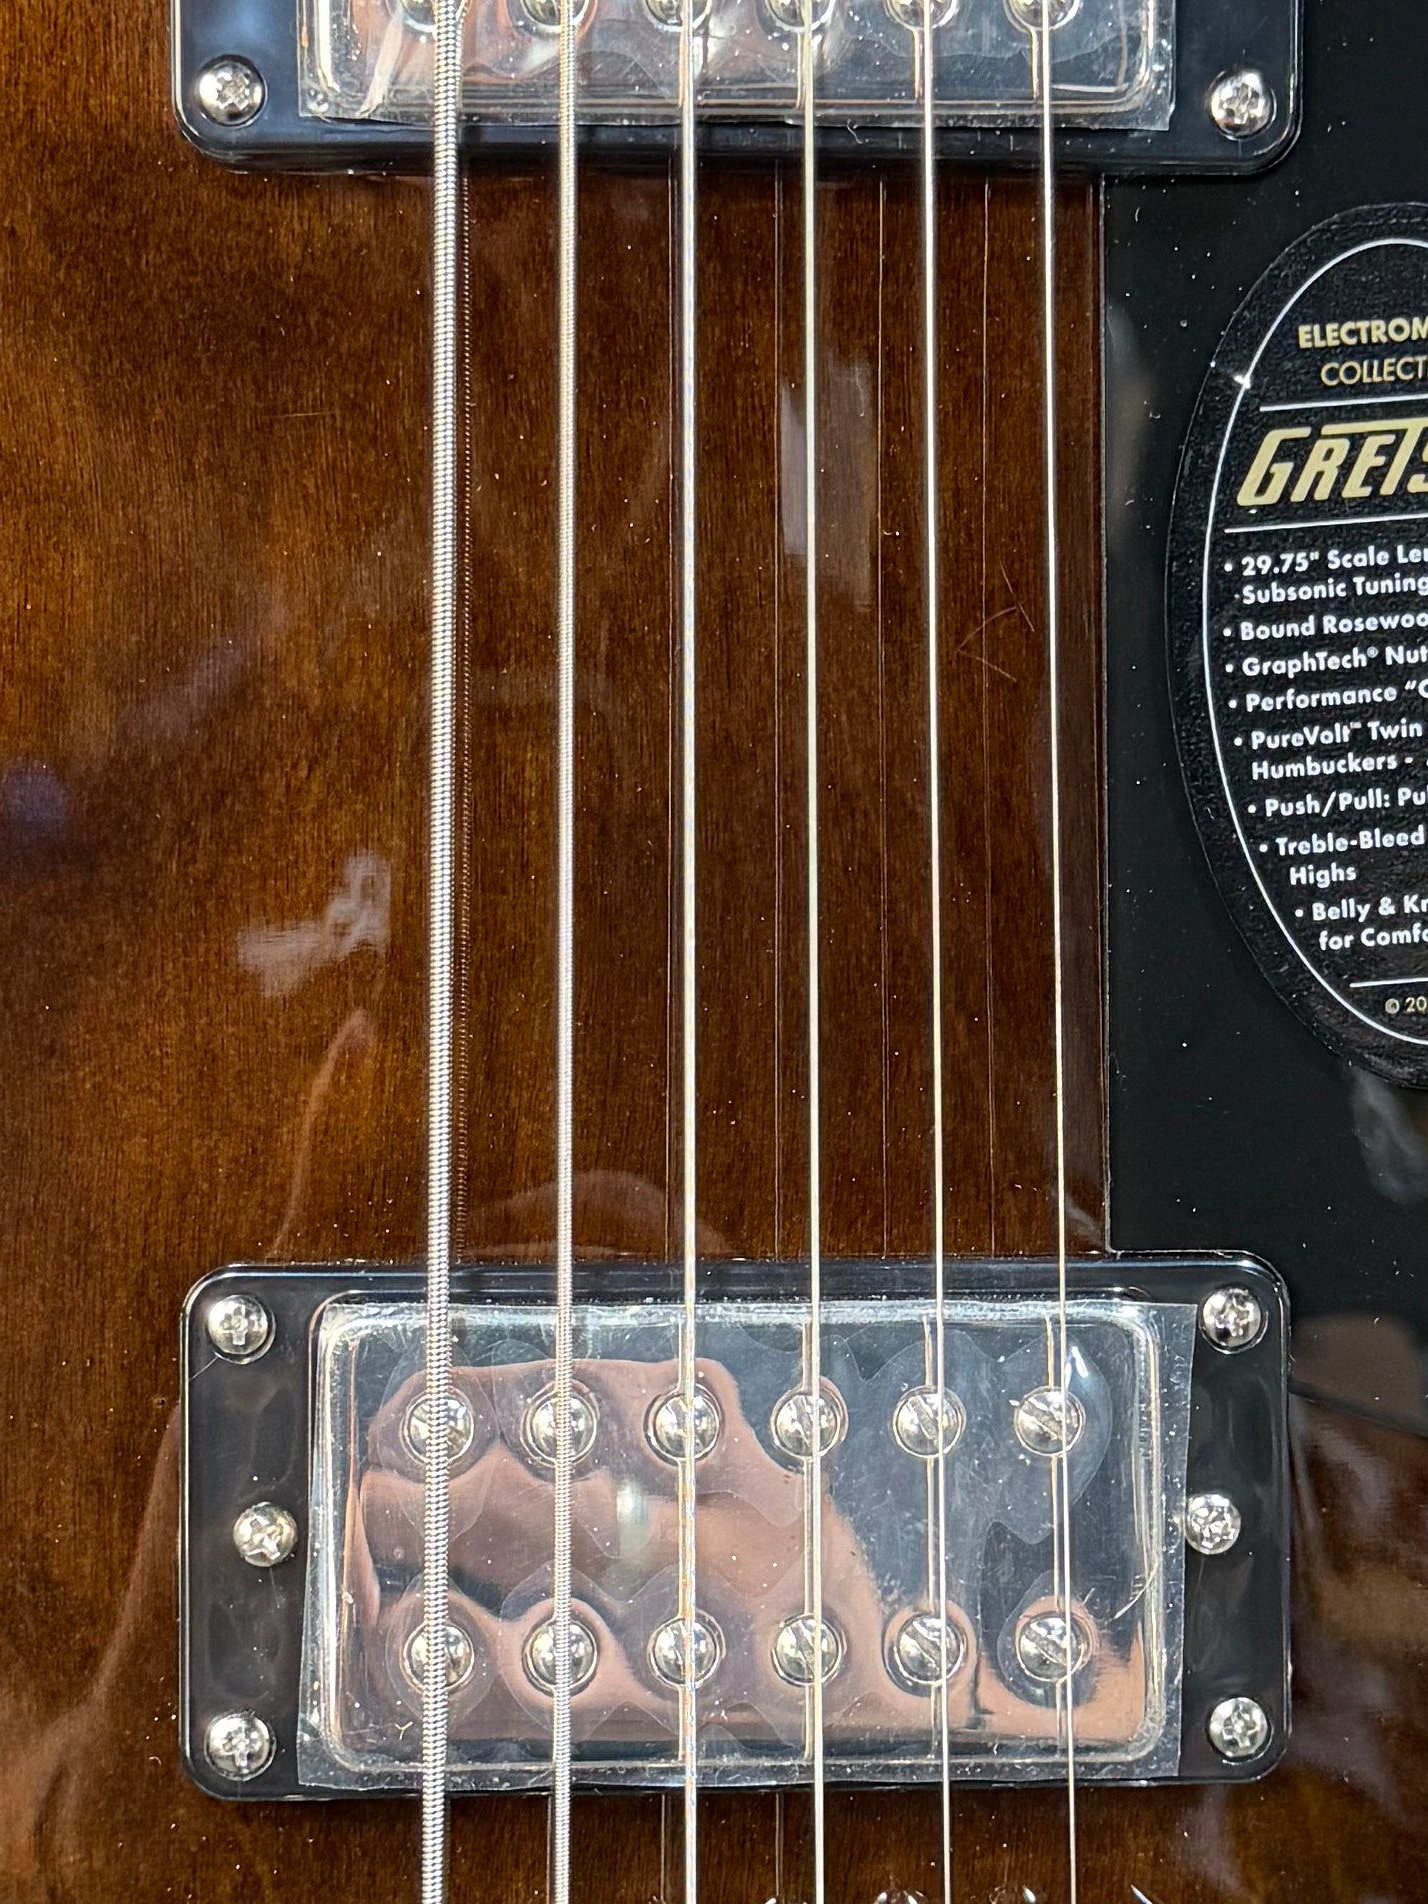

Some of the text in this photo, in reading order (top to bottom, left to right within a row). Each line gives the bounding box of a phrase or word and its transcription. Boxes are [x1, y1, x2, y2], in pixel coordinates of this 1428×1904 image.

[1327, 544, 1390, 570] Scale
[1242, 577, 1347, 605] Subsonic
[1239, 614, 1316, 641] Bound
[1384, 644, 1428, 666] Nut
[1245, 686, 1398, 713] Performance
[1366, 717, 1423, 741] Twin
[1251, 751, 1398, 781] Humbuckers
[1264, 787, 1391, 818] Push/Pull:
[1274, 823, 1426, 857] Treble-Bleed
[1289, 861, 1357, 889] Highs
[1311, 897, 1372, 923] Belly
[1377, 895, 1397, 916] &
[1318, 929, 1355, 951] for
